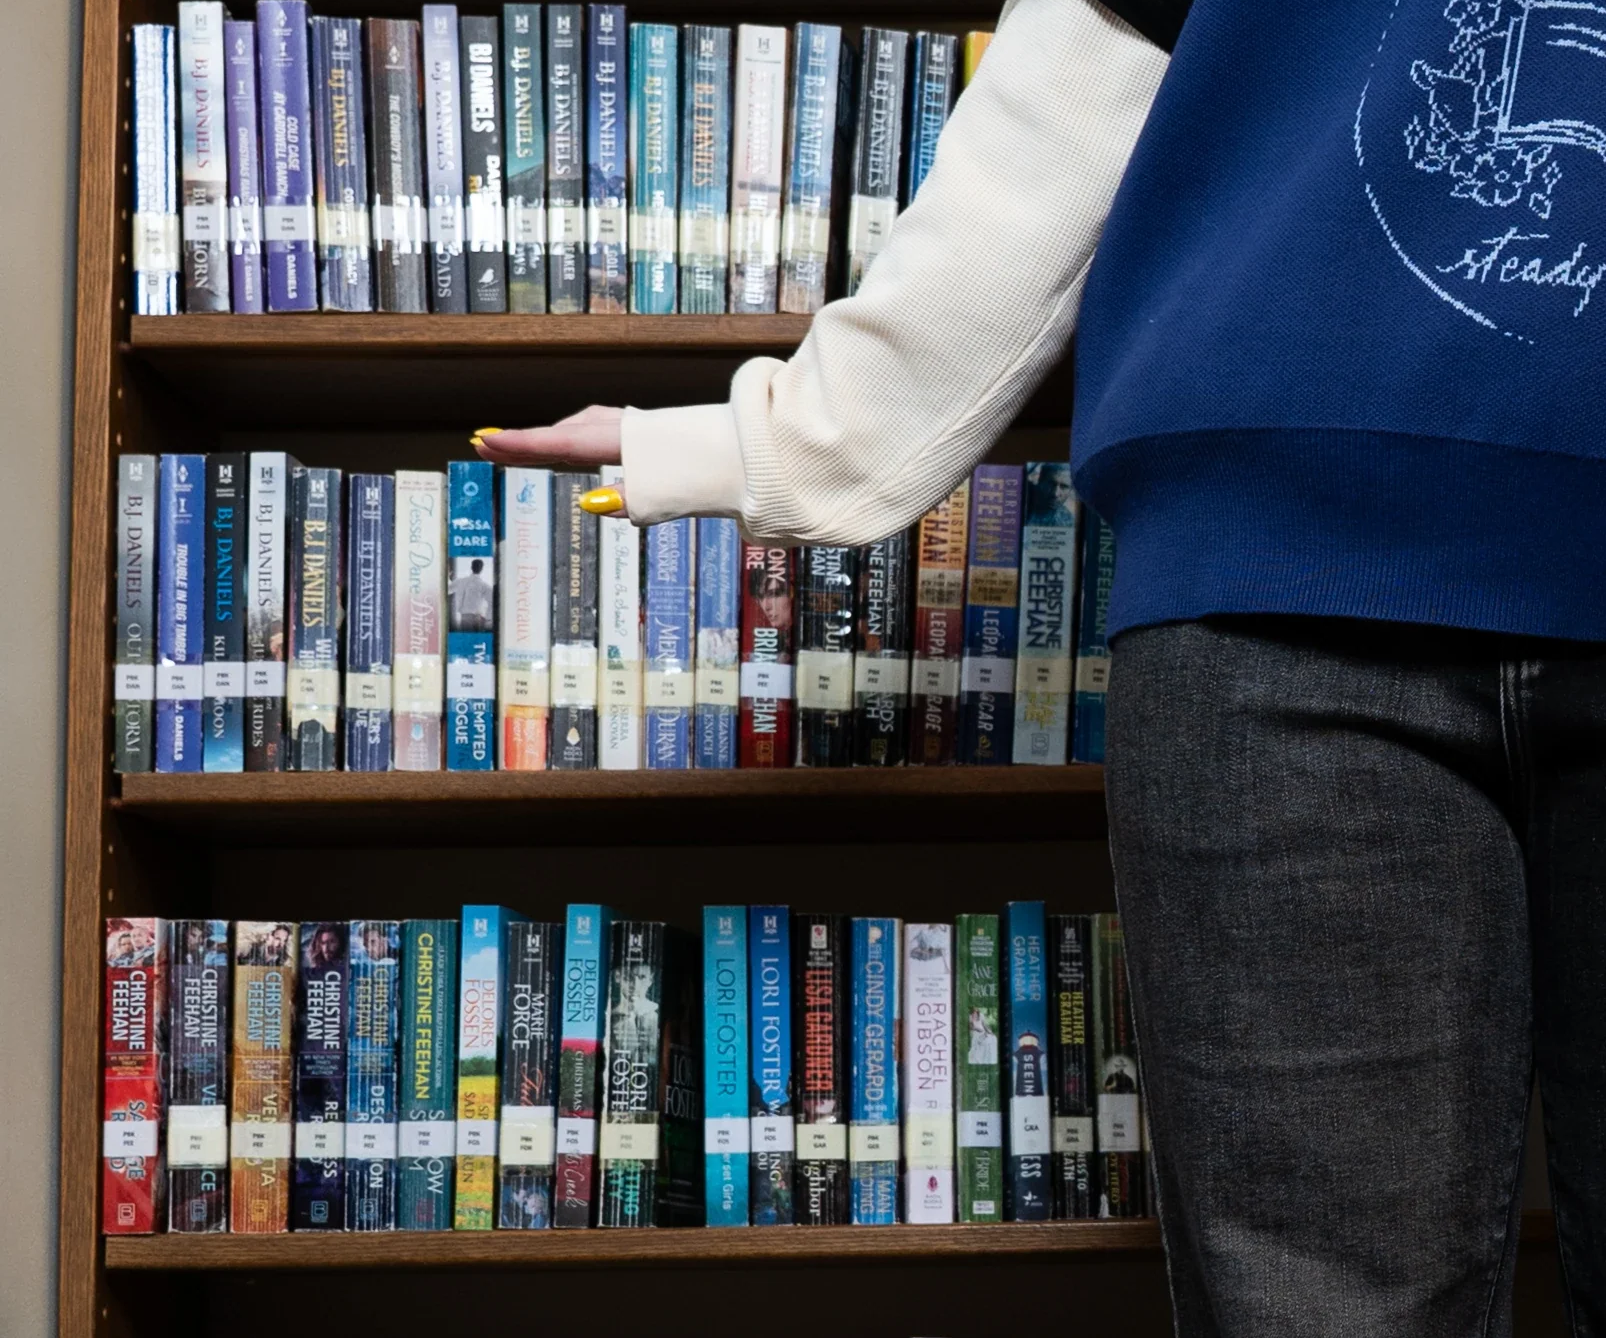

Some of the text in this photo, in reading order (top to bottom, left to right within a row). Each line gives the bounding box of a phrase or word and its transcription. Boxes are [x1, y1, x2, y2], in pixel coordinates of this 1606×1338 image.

[194, 89, 210, 168] DANIELS
[470, 43, 494, 132] BJ DANIELS
[124, 496, 143, 608] B.J. DANIELS
[215, 507, 233, 621] B.J. DANIELS
[515, 519, 538, 642] Jude Deveraux
[175, 544, 188, 661] TROUBLE IN BIG TIMBER
[1026, 557, 1045, 649] FEEHAN
[1047, 557, 1065, 648] CHRISTINE
[252, 704, 264, 748] RIDES
[112, 980, 129, 1041] FEEHAN
[129, 970, 146, 1050] CHRISTINE
[567, 958, 583, 1023] FOSSEN
[582, 959, 597, 1022] DELORES
[1013, 935, 1028, 1001] GRAHAM
[1027, 935, 1041, 1001] HEATHER
[716, 958, 736, 1094] LORI FOSTER
[806, 970, 832, 1090] LISA GARDNER
[917, 1002, 932, 1090] GIBSON
[933, 1002, 947, 1090] RACHEL
